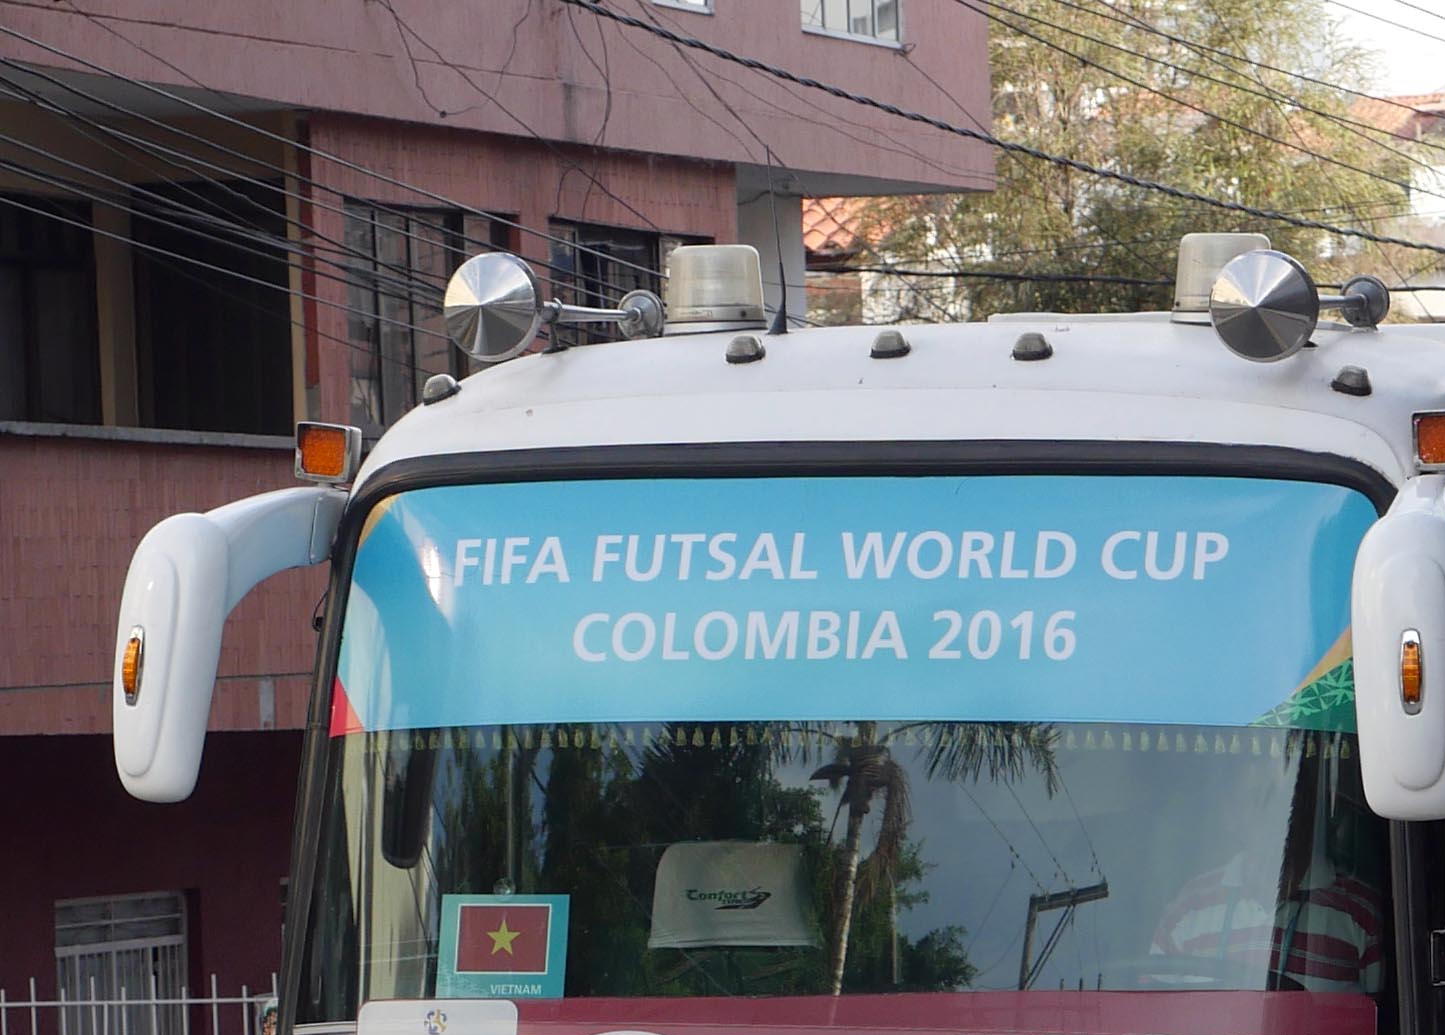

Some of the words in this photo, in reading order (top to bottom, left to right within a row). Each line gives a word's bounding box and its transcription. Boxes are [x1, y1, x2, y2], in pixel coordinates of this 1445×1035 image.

[453, 536, 571, 588] FIFA
[592, 532, 818, 583] FUTSAL
[841, 530, 1077, 580] WORLD
[1101, 530, 1229, 581] CUP
[572, 610, 908, 663] COLOMBIA
[928, 610, 1077, 661] 2016
[490, 983, 542, 995] VIETNAM
